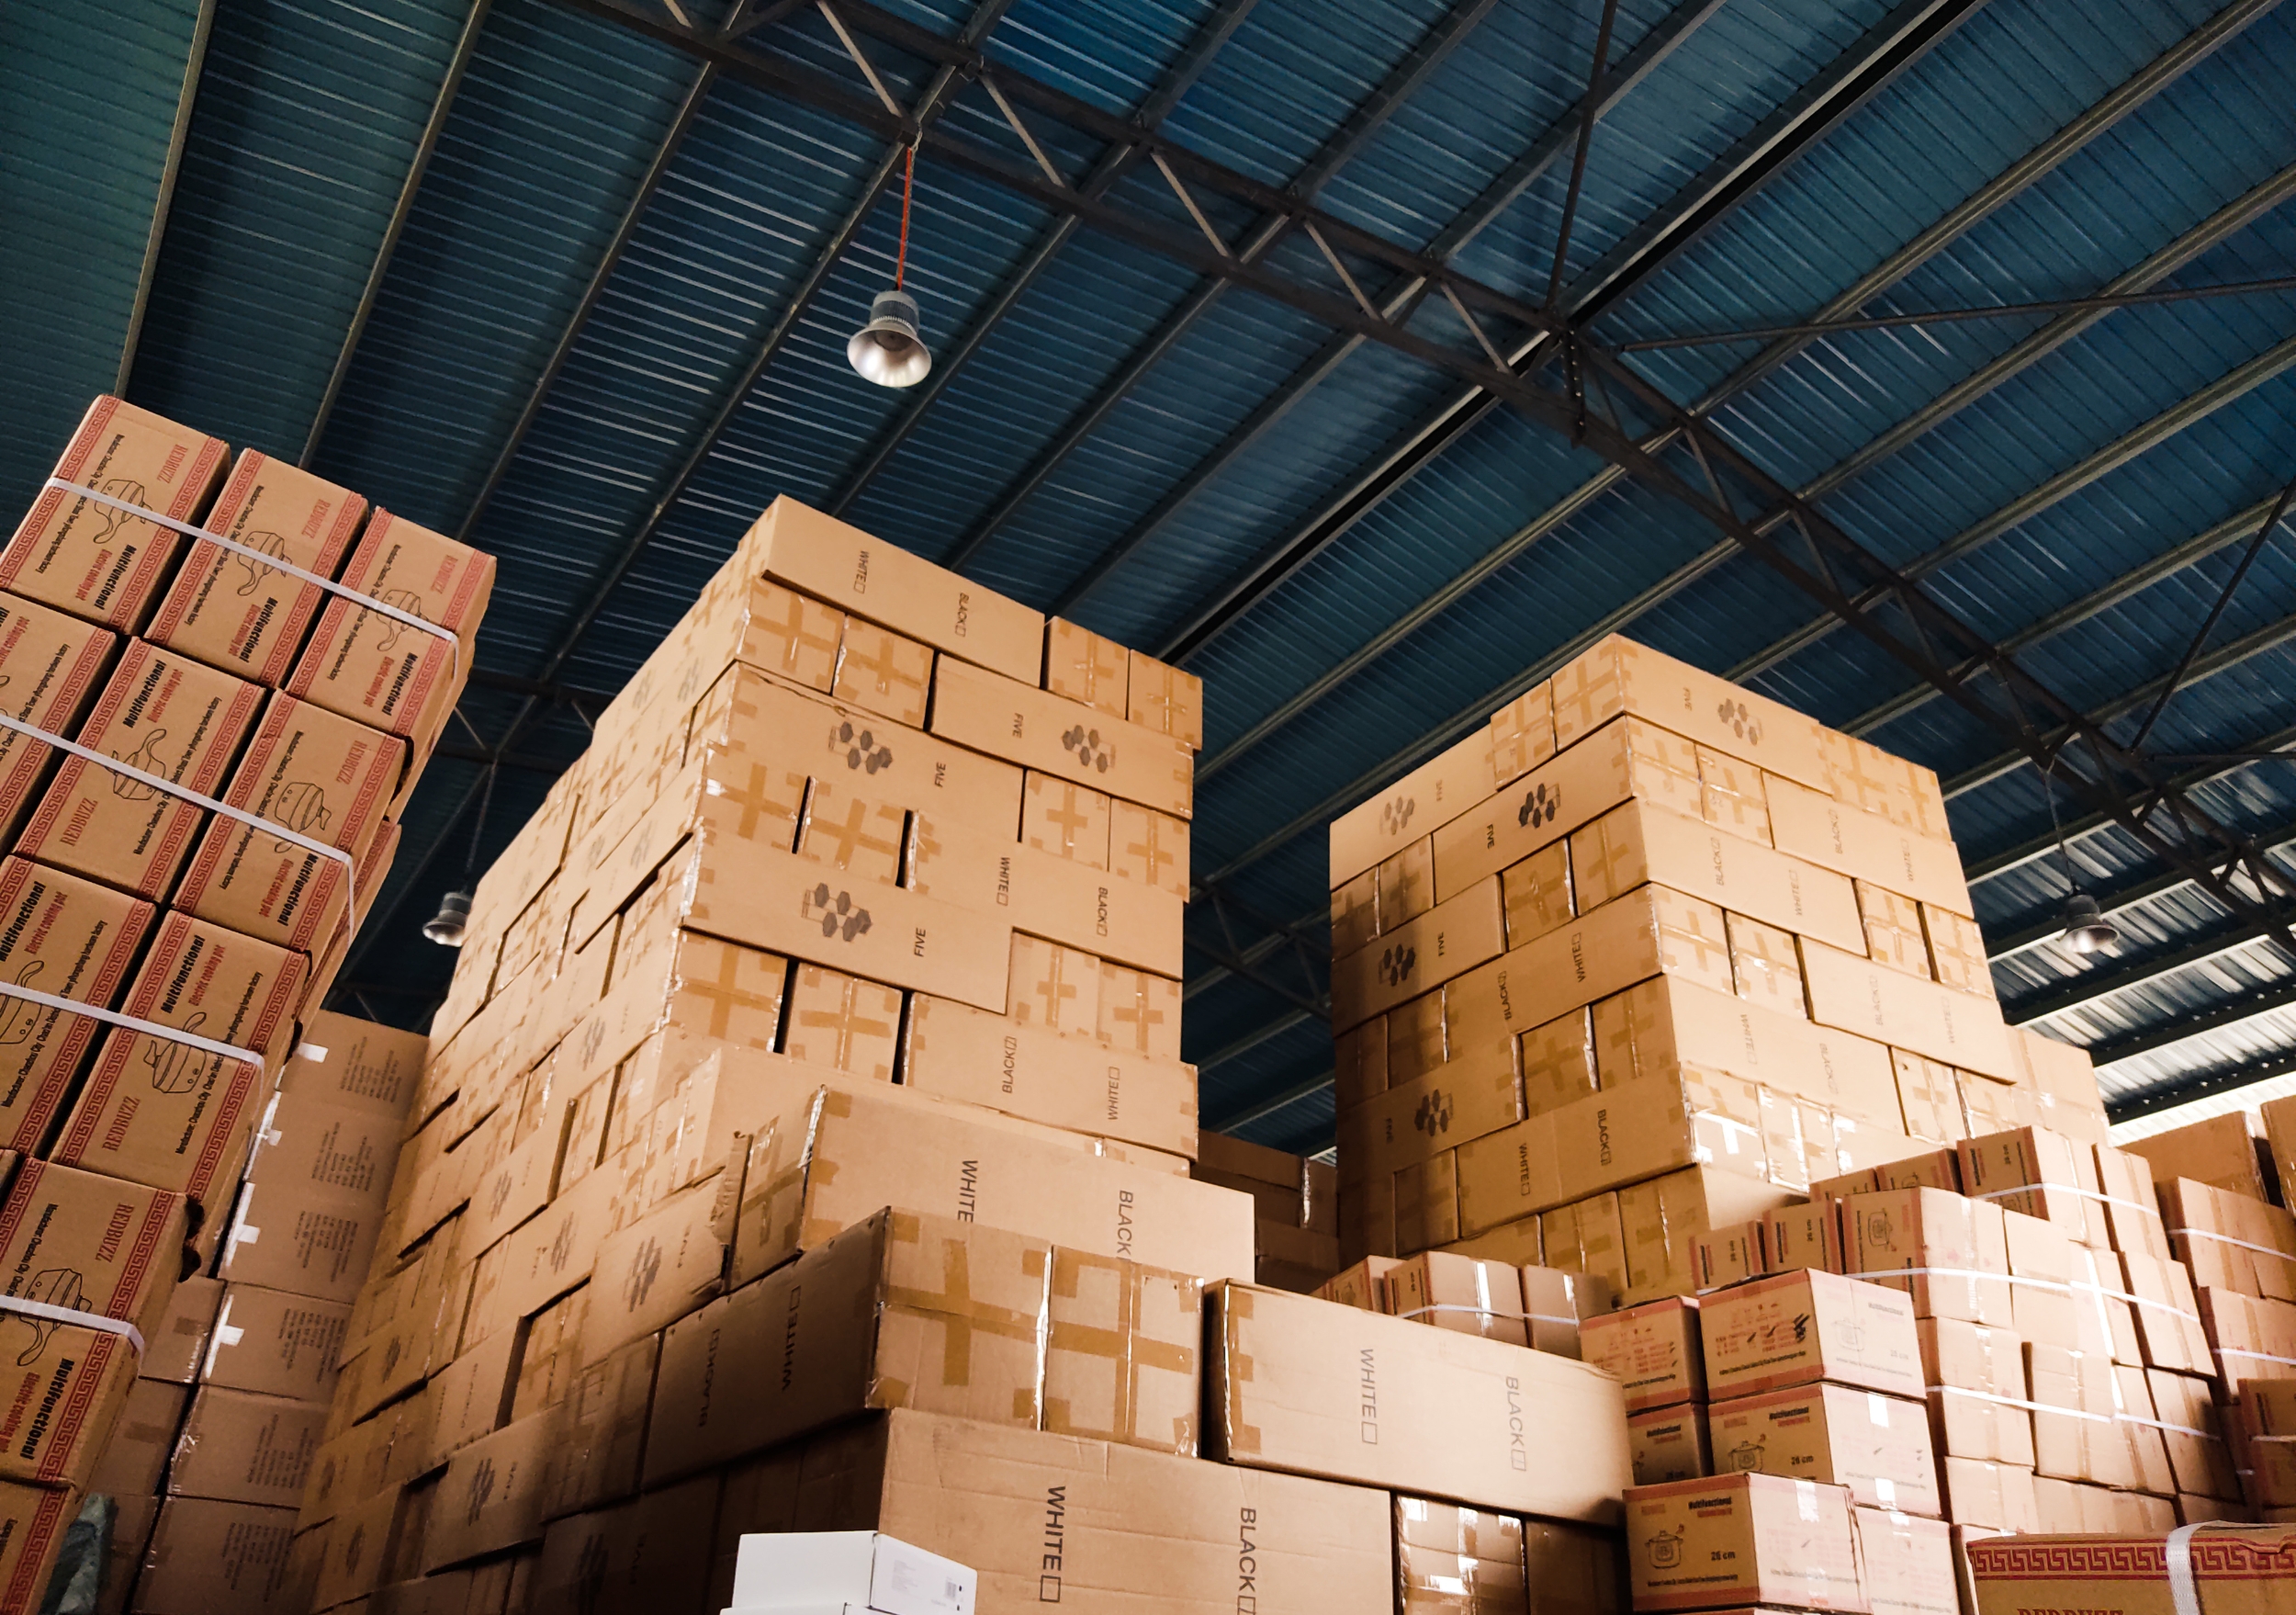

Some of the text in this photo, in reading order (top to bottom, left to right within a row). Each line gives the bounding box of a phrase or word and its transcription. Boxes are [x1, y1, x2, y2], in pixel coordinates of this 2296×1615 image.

[157, 445, 187, 483] REDBUZZ
[301, 499, 331, 538] REDBUZZ
[79, 570, 99, 591] cooking
[95, 545, 136, 610] Multifunctional
[855, 551, 869, 584] WHITE
[75, 589, 87, 601] pot
[955, 593, 969, 627] BLACK
[17, 616, 29, 628] pot
[239, 597, 277, 662] Multifunctional
[229, 644, 240, 656] pot
[123, 660, 166, 728] Multifunctional
[172, 669, 183, 682] pot
[382, 653, 418, 716] Multifunctional
[1683, 688, 1692, 710] FIVE
[1013, 713, 1023, 738] FIVE
[336, 740, 367, 785] REDBUZZ
[935, 762, 946, 787] FIVE
[60, 798, 97, 846] REDBUZZ
[1833, 821, 1842, 853] BLACK
[997, 857, 1009, 895] WHITE
[1714, 848, 1724, 886] BLACK
[1905, 853, 1913, 881] WHITE
[277, 853, 318, 926] Multifunctional
[1097, 887, 1108, 927] BLACK
[1793, 884, 1802, 915] WHITE
[24, 892, 67, 954] Electric cooking pot
[259, 904, 271, 917] pot
[914, 928, 926, 956] FIVE
[161, 935, 205, 1013] Multifunctional
[188, 944, 225, 1006] Electric cooking pot
[1572, 945, 1585, 982] WHITE
[1499, 982, 1512, 1020] BLACK
[1873, 989, 1884, 1025] BLACK
[1740, 1014, 1754, 1050] WHITE
[1944, 1011, 1955, 1044] WHITE
[1002, 1048, 1016, 1093] BLACK
[1819, 1044, 1833, 1085] BLACK
[1109, 1078, 1119, 1120] WHITE
[100, 1093, 140, 1151] REDBUZZ
[1598, 1110, 1610, 1153] BLACK
[1519, 1143, 1529, 1185] WHITE
[958, 1161, 977, 1223] WHITE
[96, 1203, 134, 1262] REDBUZZ
[1118, 1191, 1133, 1254] BLACK
[15, 1264, 30, 1274] City
[781, 1315, 797, 1390] WHITE
[1361, 1350, 1376, 1417] WHITE
[0, 1372, 40, 1437] Electric cooking
[20, 1358, 74, 1460] Multifunctional
[1506, 1376, 1524, 1446] BLACK
[1043, 1486, 1065, 1571] WHITE
[1238, 1508, 1255, 1597] BLACK
